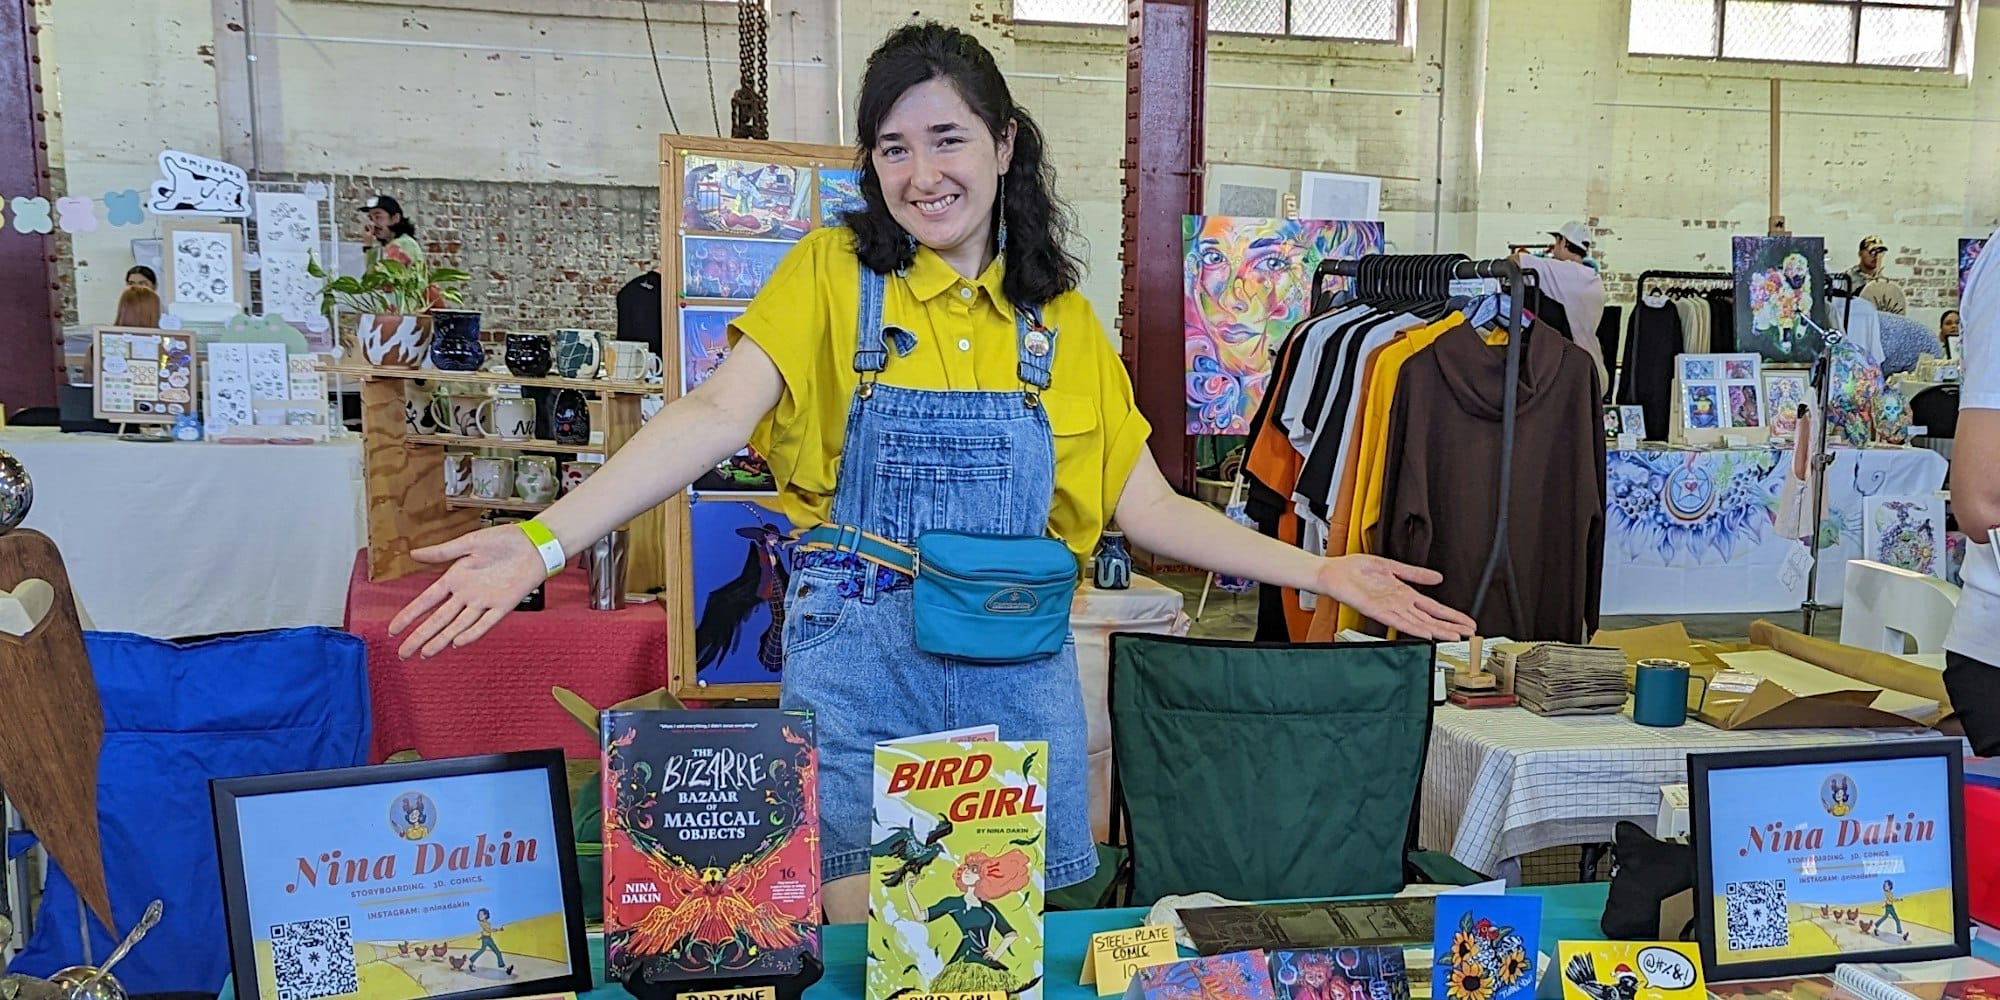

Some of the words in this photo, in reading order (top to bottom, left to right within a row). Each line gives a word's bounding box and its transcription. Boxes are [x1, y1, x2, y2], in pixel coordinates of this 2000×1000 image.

[691, 749, 713, 758] THE
[662, 748, 767, 794] BIZARRE
[887, 753, 993, 795] BIRD
[678, 791, 739, 804] BAZAAR
[949, 784, 1044, 823] GIRL
[663, 811, 760, 828] MAGICAL
[678, 828, 746, 841] OBJECTS
[1739, 821, 1824, 857] Nina
[1837, 812, 1935, 848] Dakin
[285, 849, 396, 894] Nina
[412, 831, 538, 876] Dakin
[779, 866, 796, 880] 16
[625, 883, 658, 893] NINA
[621, 893, 661, 905] DAKIN
[367, 906, 420, 920] INSTAGRAM:
[422, 901, 470, 914] @ninadakin
[1112, 945, 1150, 960] COMIC
